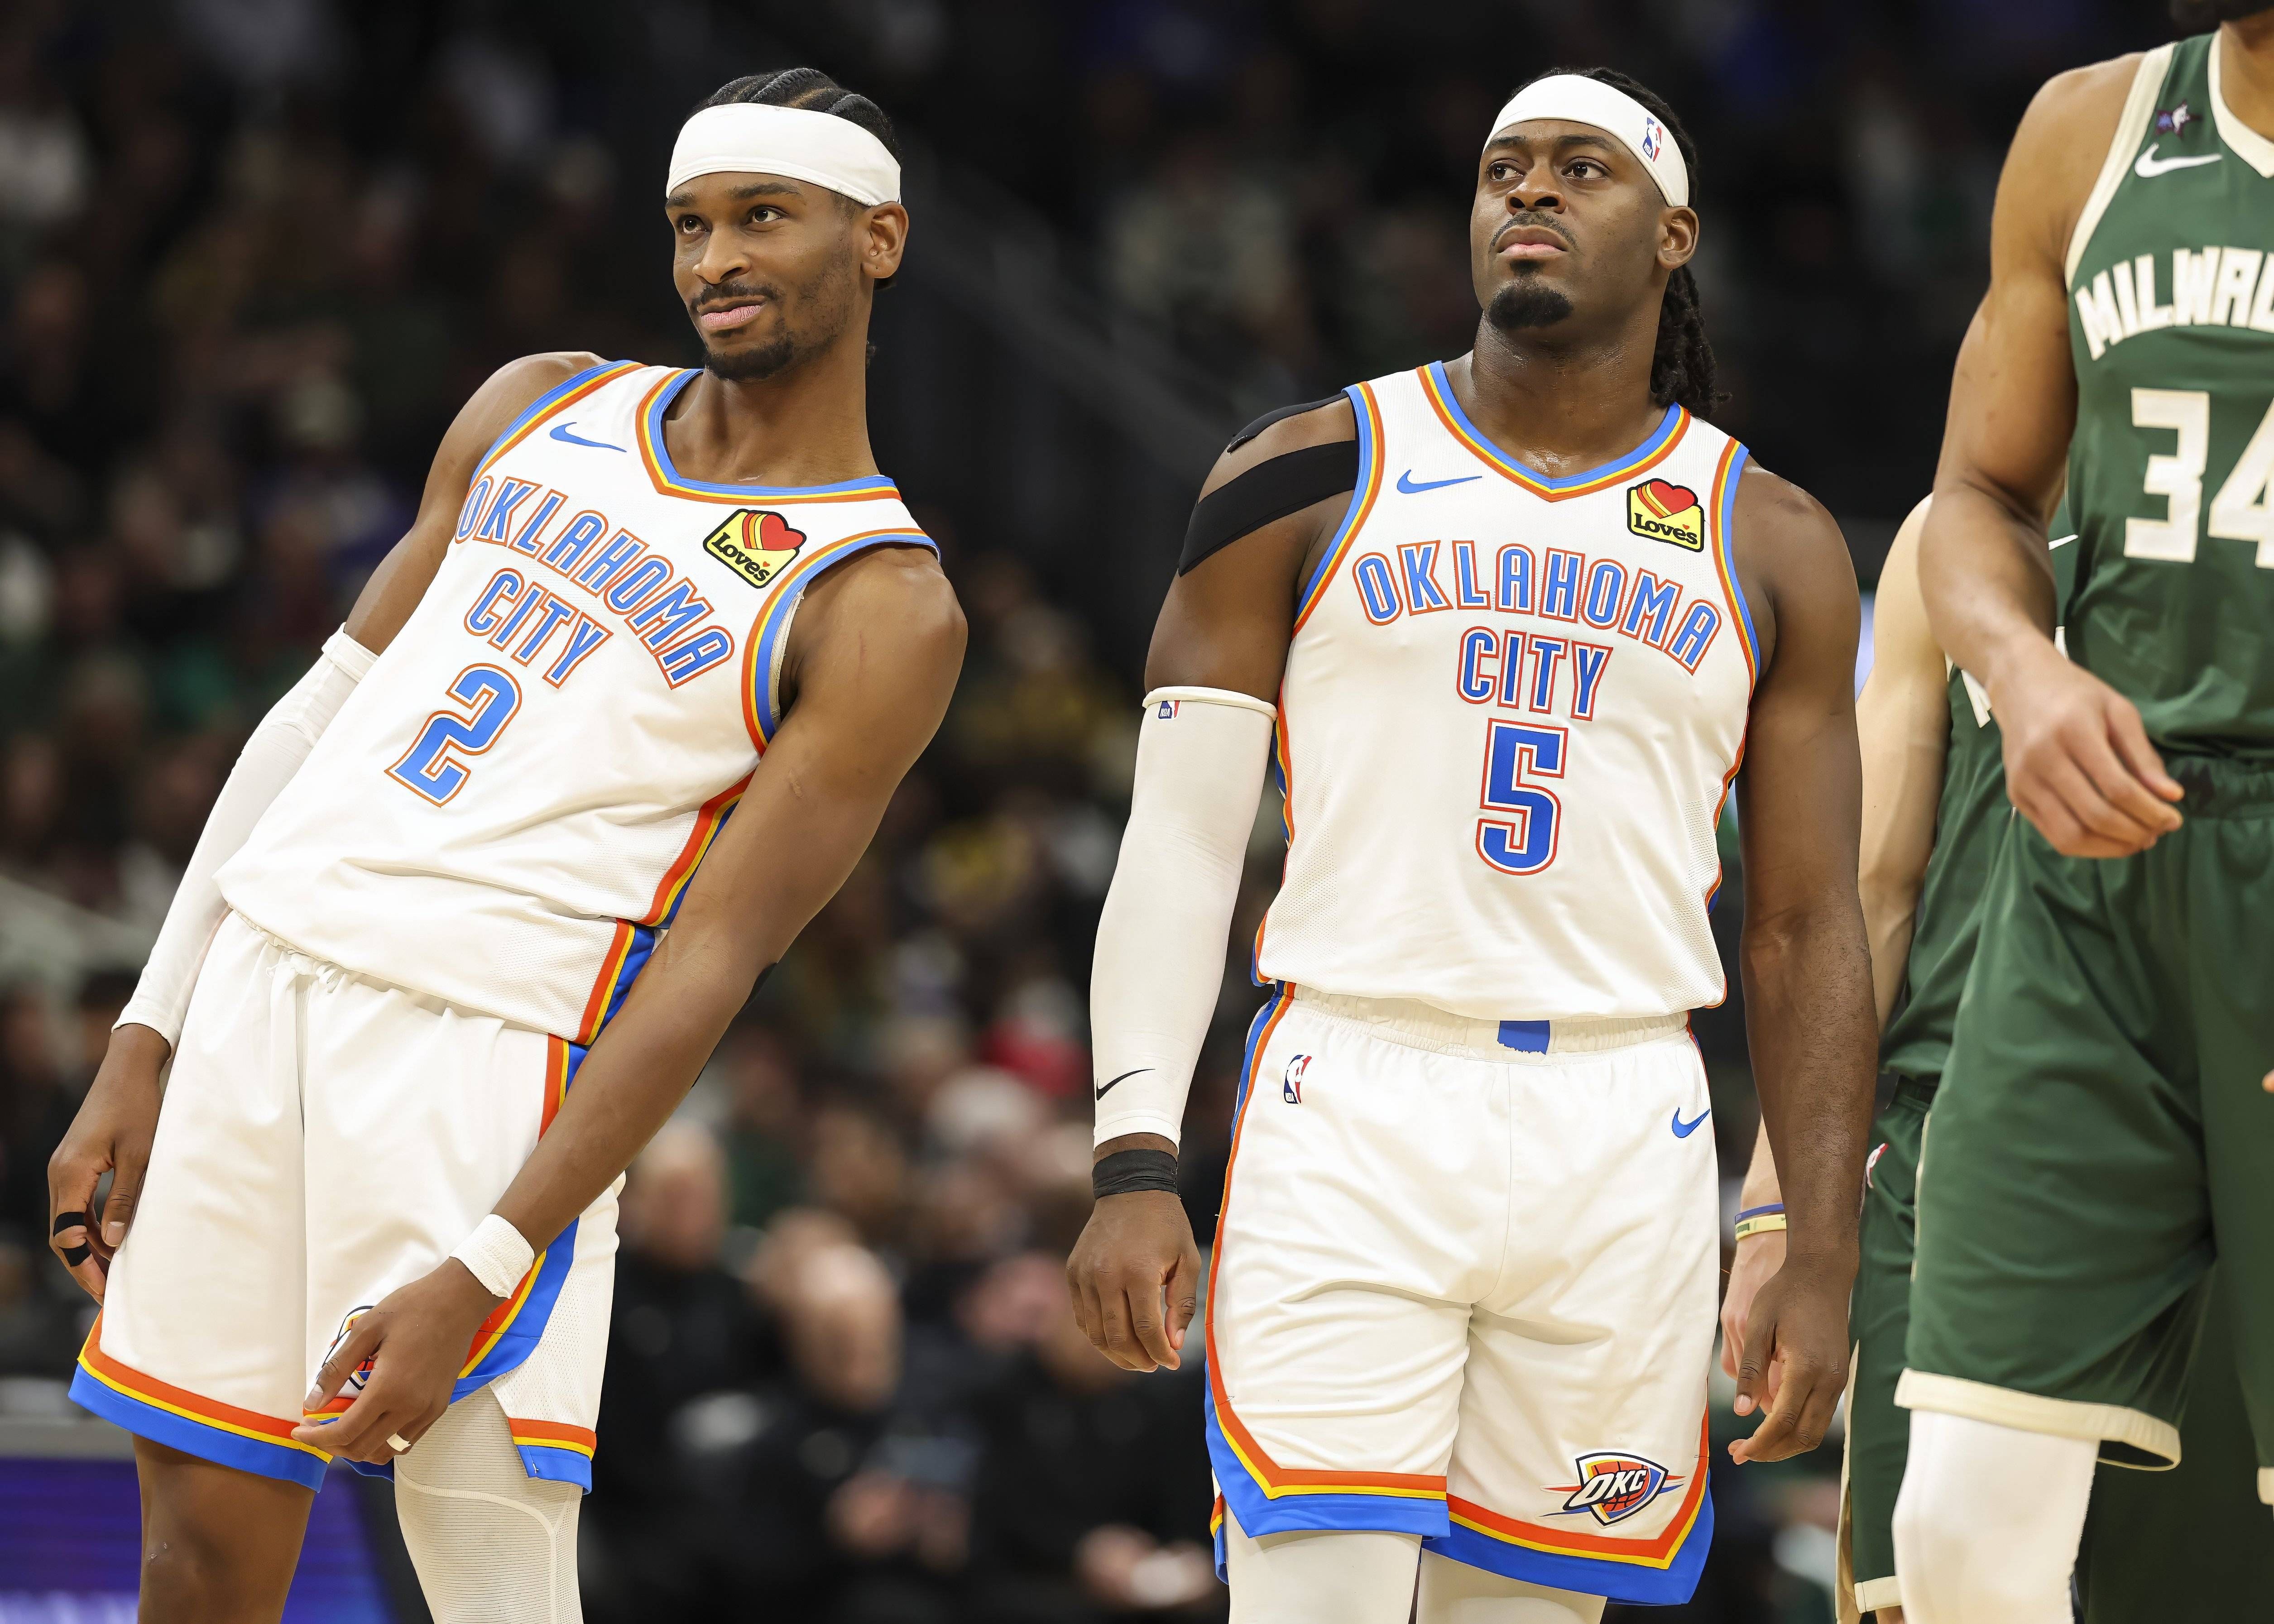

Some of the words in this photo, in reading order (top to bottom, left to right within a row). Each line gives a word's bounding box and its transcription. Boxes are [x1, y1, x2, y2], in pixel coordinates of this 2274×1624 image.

[2123, 387, 2274, 570] 34
[455, 475, 734, 690] OKLAHOMA
[464, 567, 613, 689] CITY
[1353, 540, 1722, 675] OKLAHOMA
[384, 663, 522, 807] 2
[1457, 626, 1613, 721] CITY
[1475, 718, 1569, 876] 5
[1568, 1469, 1648, 1507] OKC
